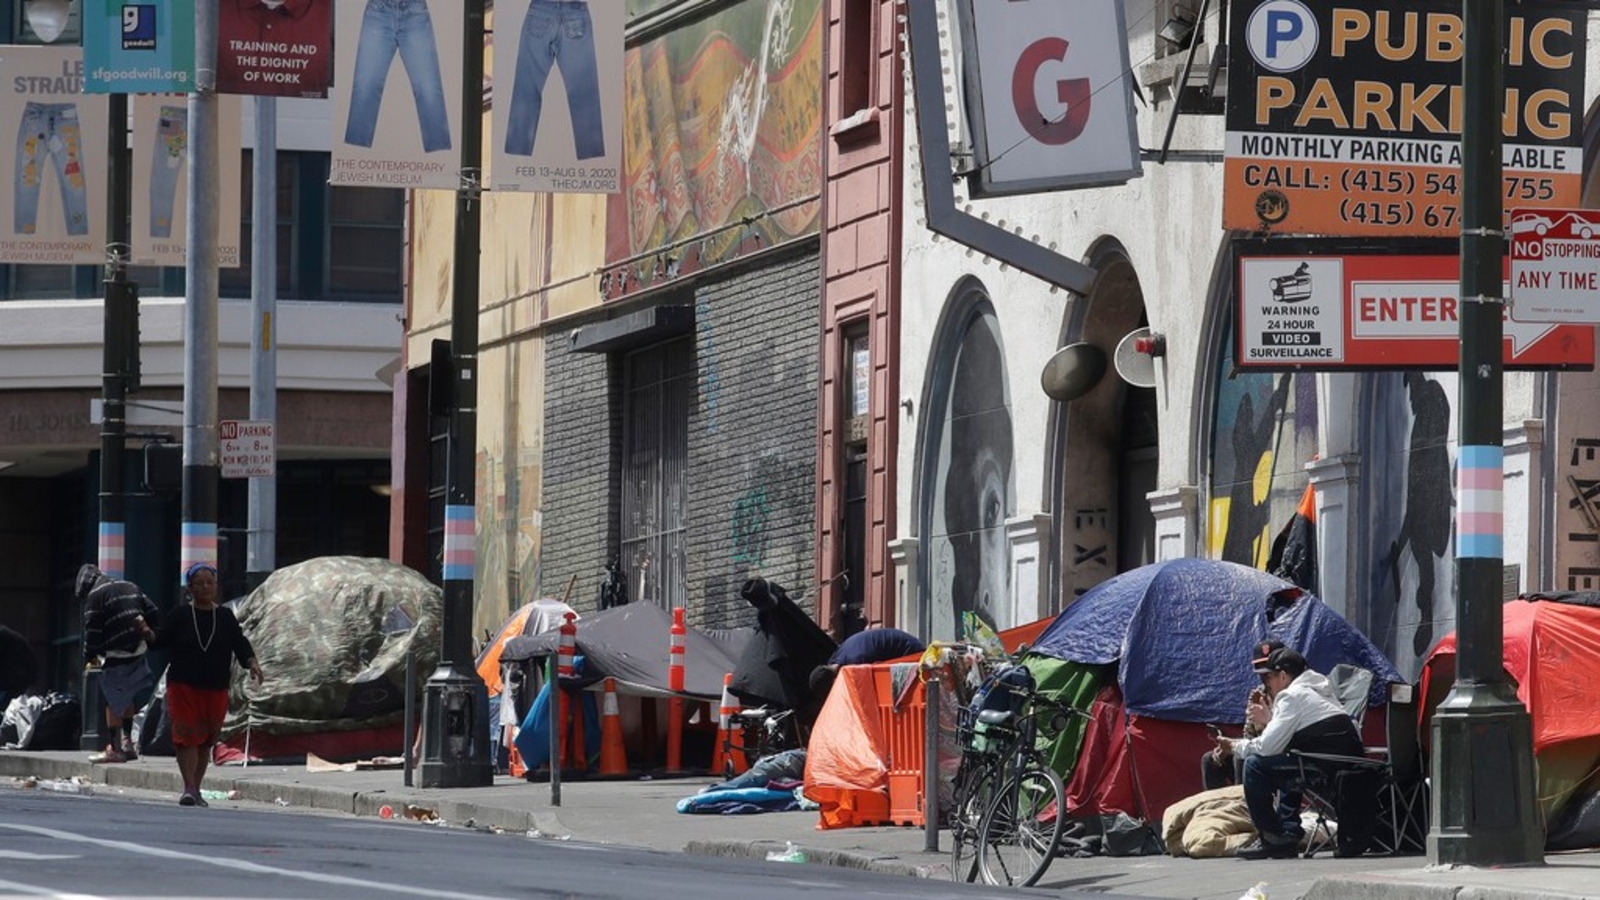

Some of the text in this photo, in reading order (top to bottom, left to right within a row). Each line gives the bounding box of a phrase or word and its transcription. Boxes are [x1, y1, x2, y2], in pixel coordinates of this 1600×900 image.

[1266, 10, 1304, 58] P
[1331, 8, 1574, 69] PUBIC
[229, 40, 318, 56] TRAINING AND
[236, 56, 309, 70] THE DIGNITY
[92, 68, 188, 82] sfgoodwill.org
[243, 71, 301, 84] OF WORK
[14, 77, 84, 94] STRAU
[1012, 37, 1091, 145] G
[1241, 135, 1566, 170] MONTHLY PARKING AABLE
[336, 159, 446, 173] THE CONTEMPORARY
[515, 166, 536, 177] FEB
[539, 166, 575, 177] 13-AUG
[590, 168, 617, 178] 2020
[335, 171, 422, 184] JEWISH MUSEUM
[552, 179, 616, 190] THECJM.ORG
[1244, 165, 1330, 190] CALL:
[1340, 168, 1415, 195] (415)
[1339, 198, 1414, 225] (415)
[0, 241, 93, 252] THE CONTEMPORARY
[152, 244, 169, 254] FEB
[1514, 241, 1600, 259] NO STOPPING
[35, 252, 75, 262] MUSEUM
[1517, 271, 1598, 290] ANY TIME
[1262, 306, 1320, 316] WARNING
[1360, 297, 1458, 322] ENTER
[1267, 320, 1315, 330] 24 HOUR
[1272, 333, 1311, 344] VIDEO
[1249, 348, 1333, 358] SURVEILLANCE
[221, 422, 273, 438] NO PARKING
